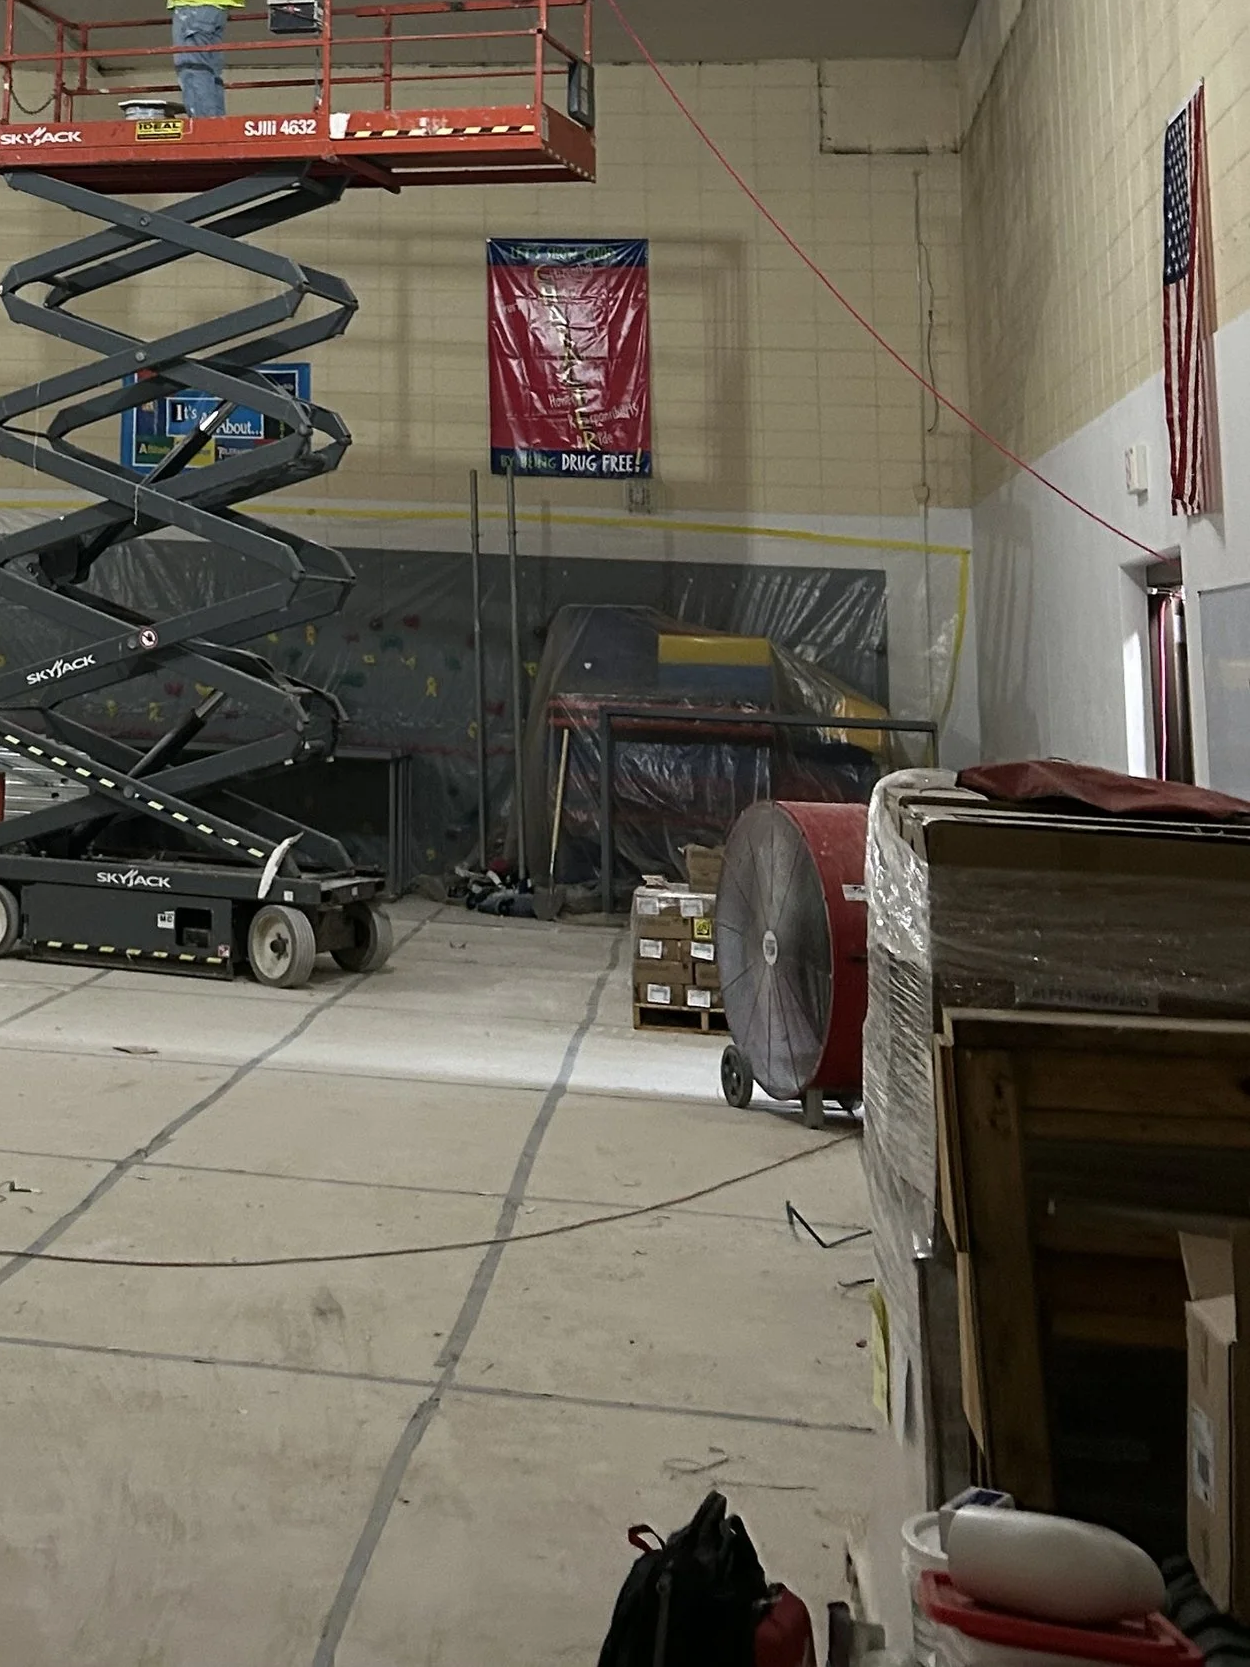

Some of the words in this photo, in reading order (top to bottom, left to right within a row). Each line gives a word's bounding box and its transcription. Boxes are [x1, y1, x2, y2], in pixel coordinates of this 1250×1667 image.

[0, 126, 83, 147] SKYJACK
[138, 121, 181, 131] IDEAL
[279, 119, 317, 135] 4632
[175, 403, 198, 422] It's
[561, 453, 598, 472] DRUG
[602, 447, 642, 473] FREE!
[25, 653, 97, 685] SKYJACK
[96, 868, 172, 889] SKYJACK
